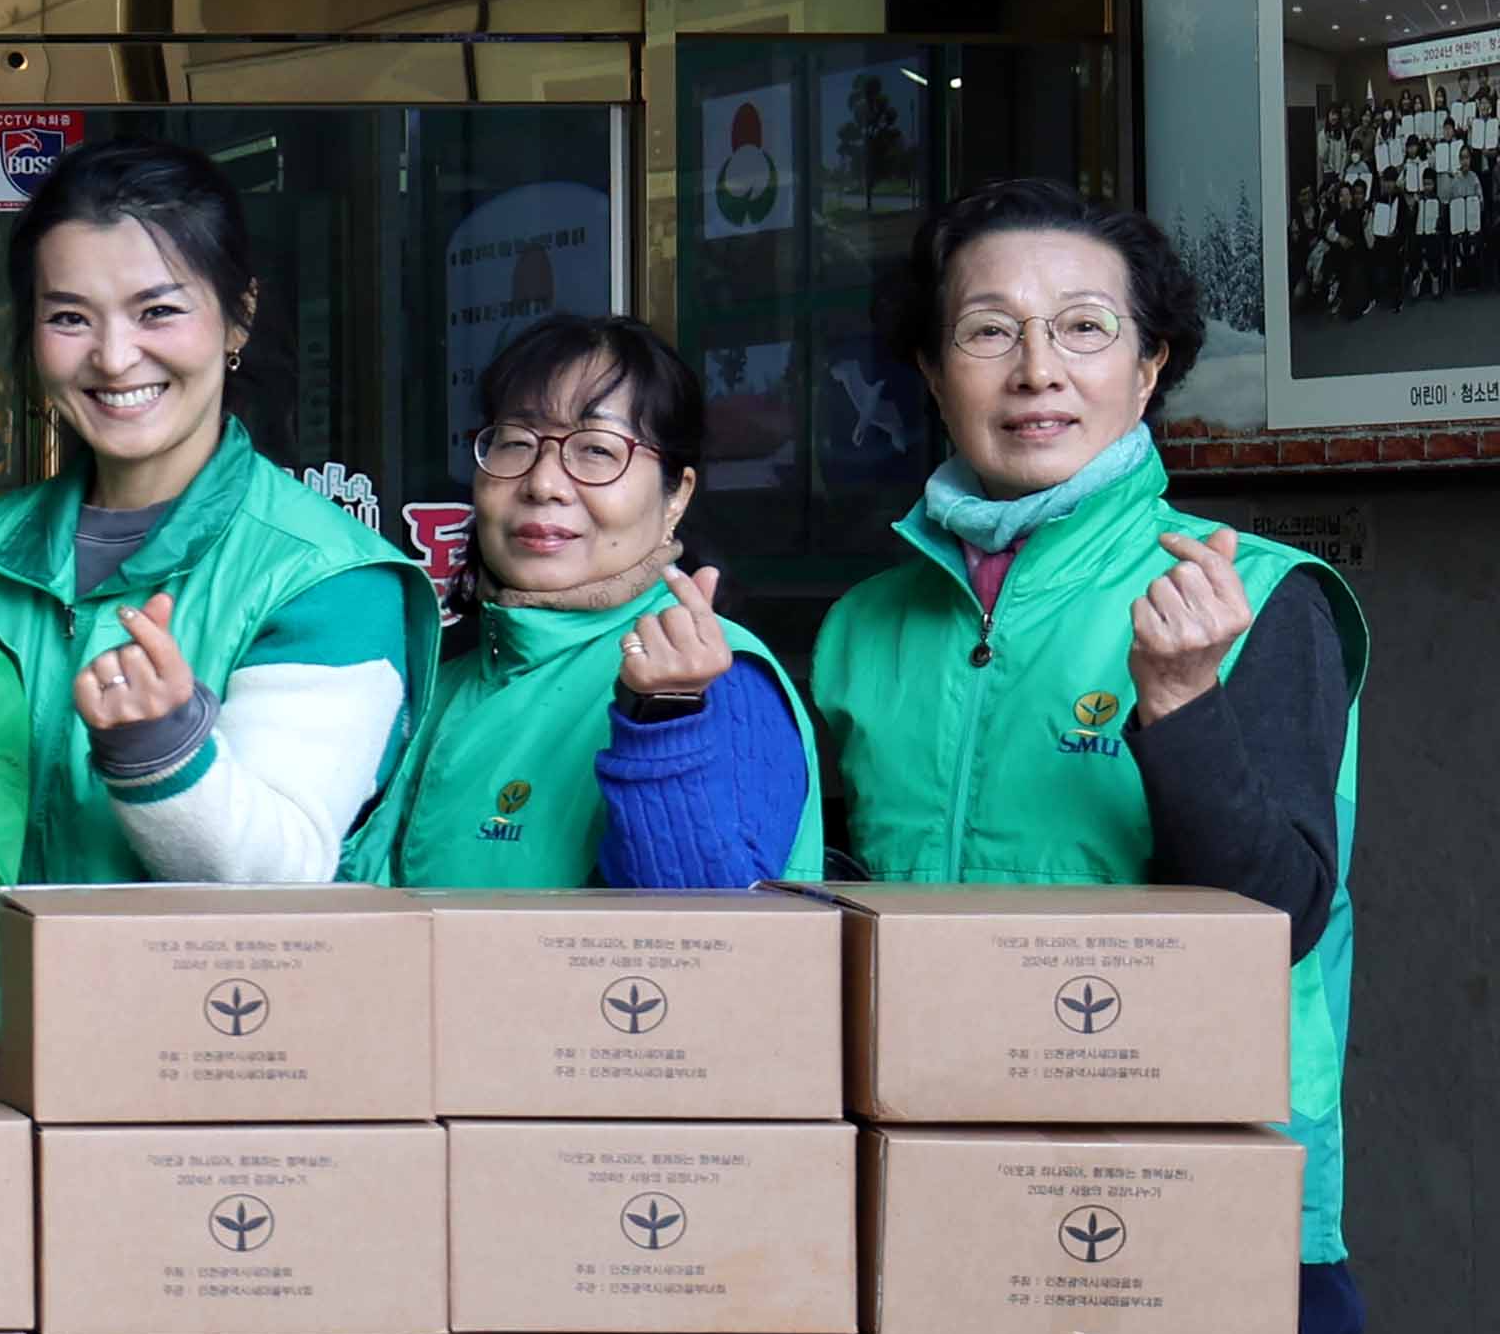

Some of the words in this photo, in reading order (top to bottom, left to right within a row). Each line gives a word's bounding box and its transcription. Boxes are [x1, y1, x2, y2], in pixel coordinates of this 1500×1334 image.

[1410, 384, 1448, 407] 어린이
[1460, 380, 1500, 404] 청소년
[1057, 734, 1121, 758] SMU
[476, 822, 524, 842] SMU
[1092, 1166, 1136, 1180] 함께하는
[1026, 1184, 1065, 1197] 2024년
[1070, 1185, 1103, 1198] 사랑의
[1106, 1186, 1162, 1199] 김장나누기
[1045, 1275, 1143, 1289] 인천광역시새마을회
[1043, 1293, 1163, 1308] 인천광역시새마을부녀회
